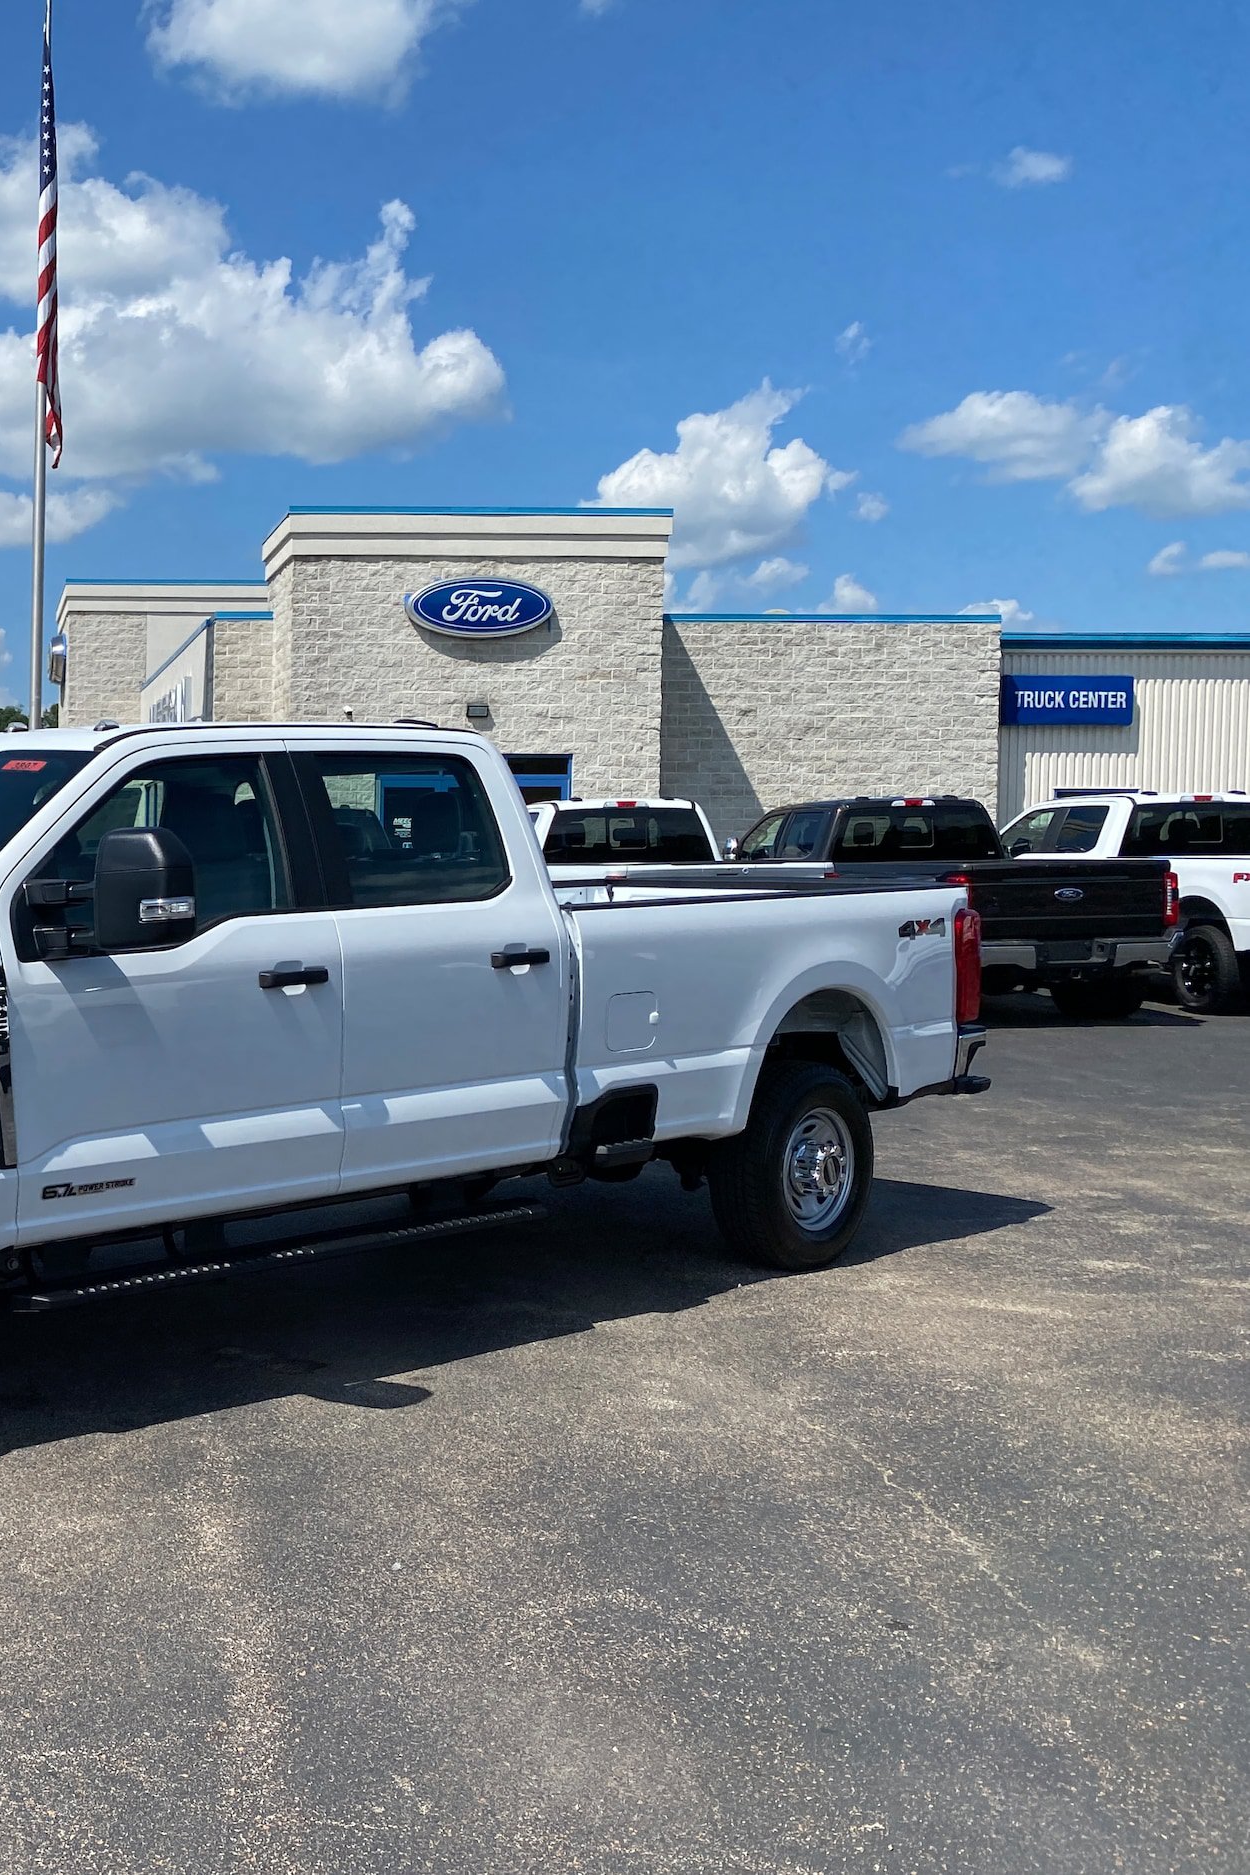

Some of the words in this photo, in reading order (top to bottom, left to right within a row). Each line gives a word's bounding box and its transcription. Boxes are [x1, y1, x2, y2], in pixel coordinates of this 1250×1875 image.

[442, 589, 522, 622] Ford
[1015, 691, 1065, 709] TRUCK
[1069, 691, 1127, 709] CENTER
[42, 1182, 77, 1200] 6.7L
[78, 1183, 104, 1192] POWER
